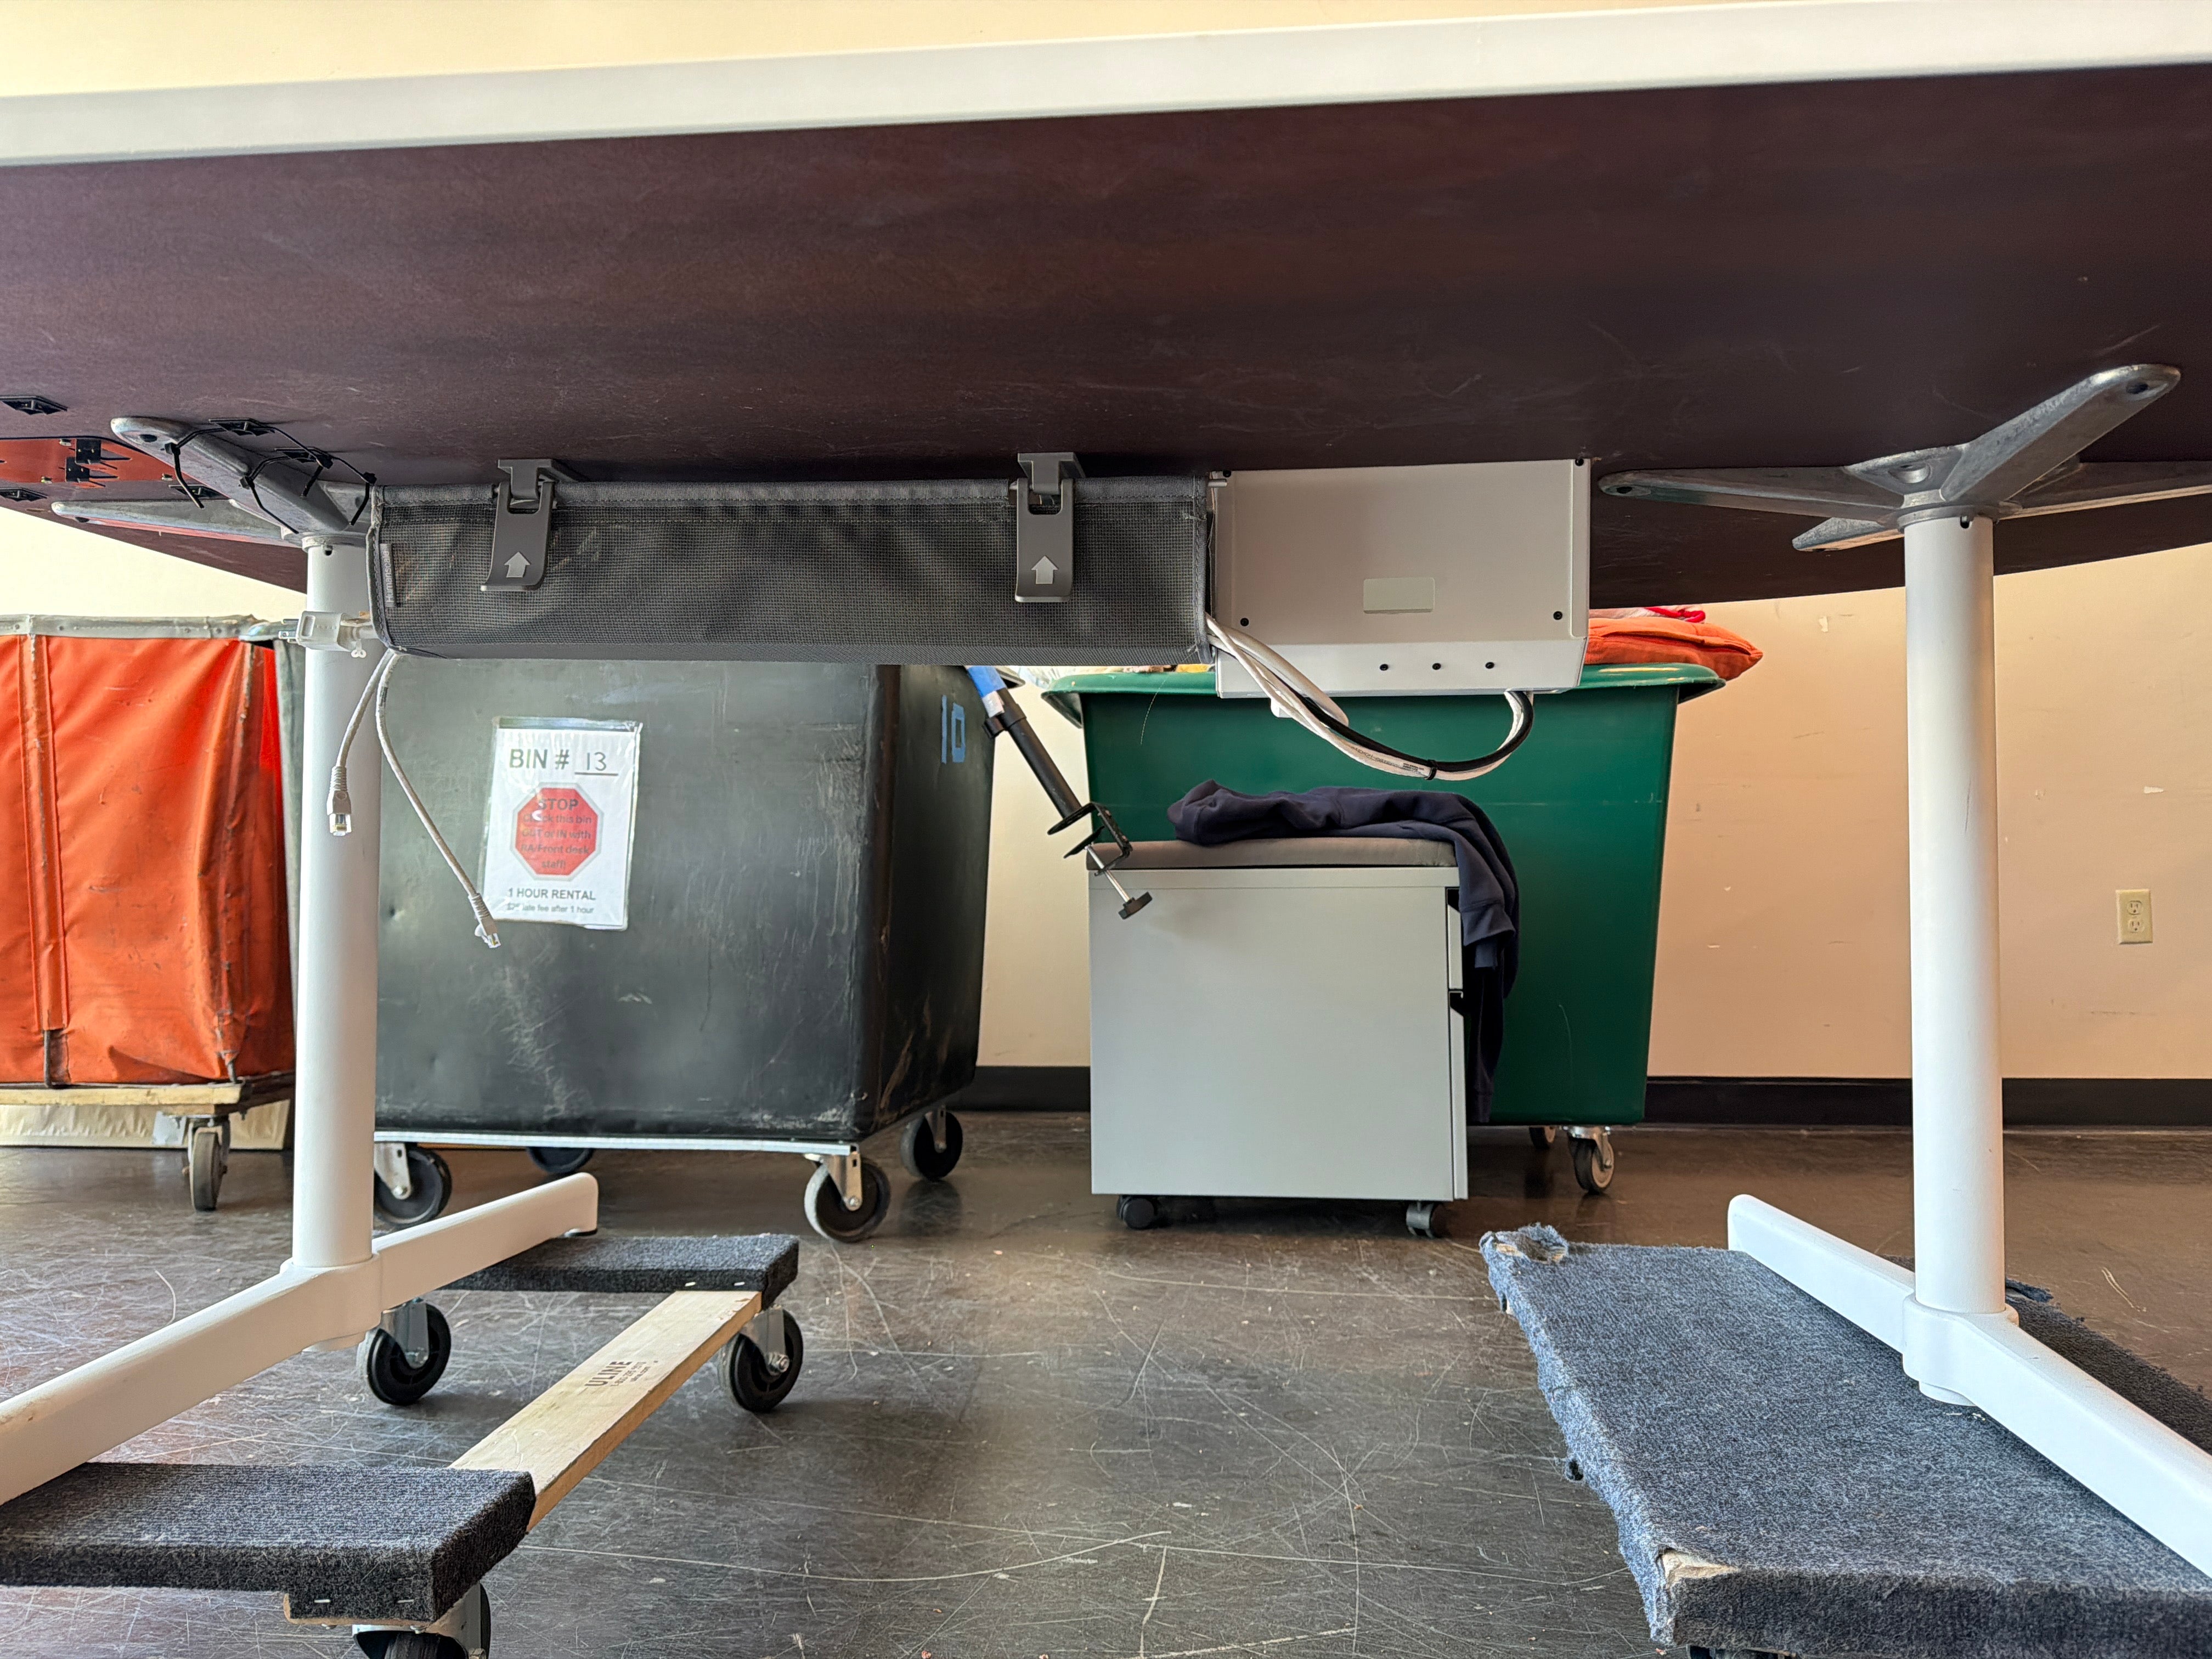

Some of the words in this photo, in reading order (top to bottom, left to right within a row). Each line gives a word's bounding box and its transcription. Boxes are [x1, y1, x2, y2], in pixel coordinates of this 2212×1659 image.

[382, 550, 394, 603] Humanscale
[509, 748, 548, 769] BIN
[555, 749, 570, 770] #
[586, 752, 607, 771] 13
[538, 798, 579, 811] STOP
[556, 815, 574, 823] this
[575, 815, 592, 824] bin
[521, 828, 543, 837] OUT
[556, 830, 567, 838] IN
[569, 830, 591, 839] with
[566, 845, 590, 854] desk
[507, 887, 514, 898] 1
[516, 888, 549, 899] HOUR
[551, 889, 596, 901] RENTAL
[551, 904, 568, 912] after
[576, 906, 595, 915] hour
[584, 1361, 633, 1387] ULINE
